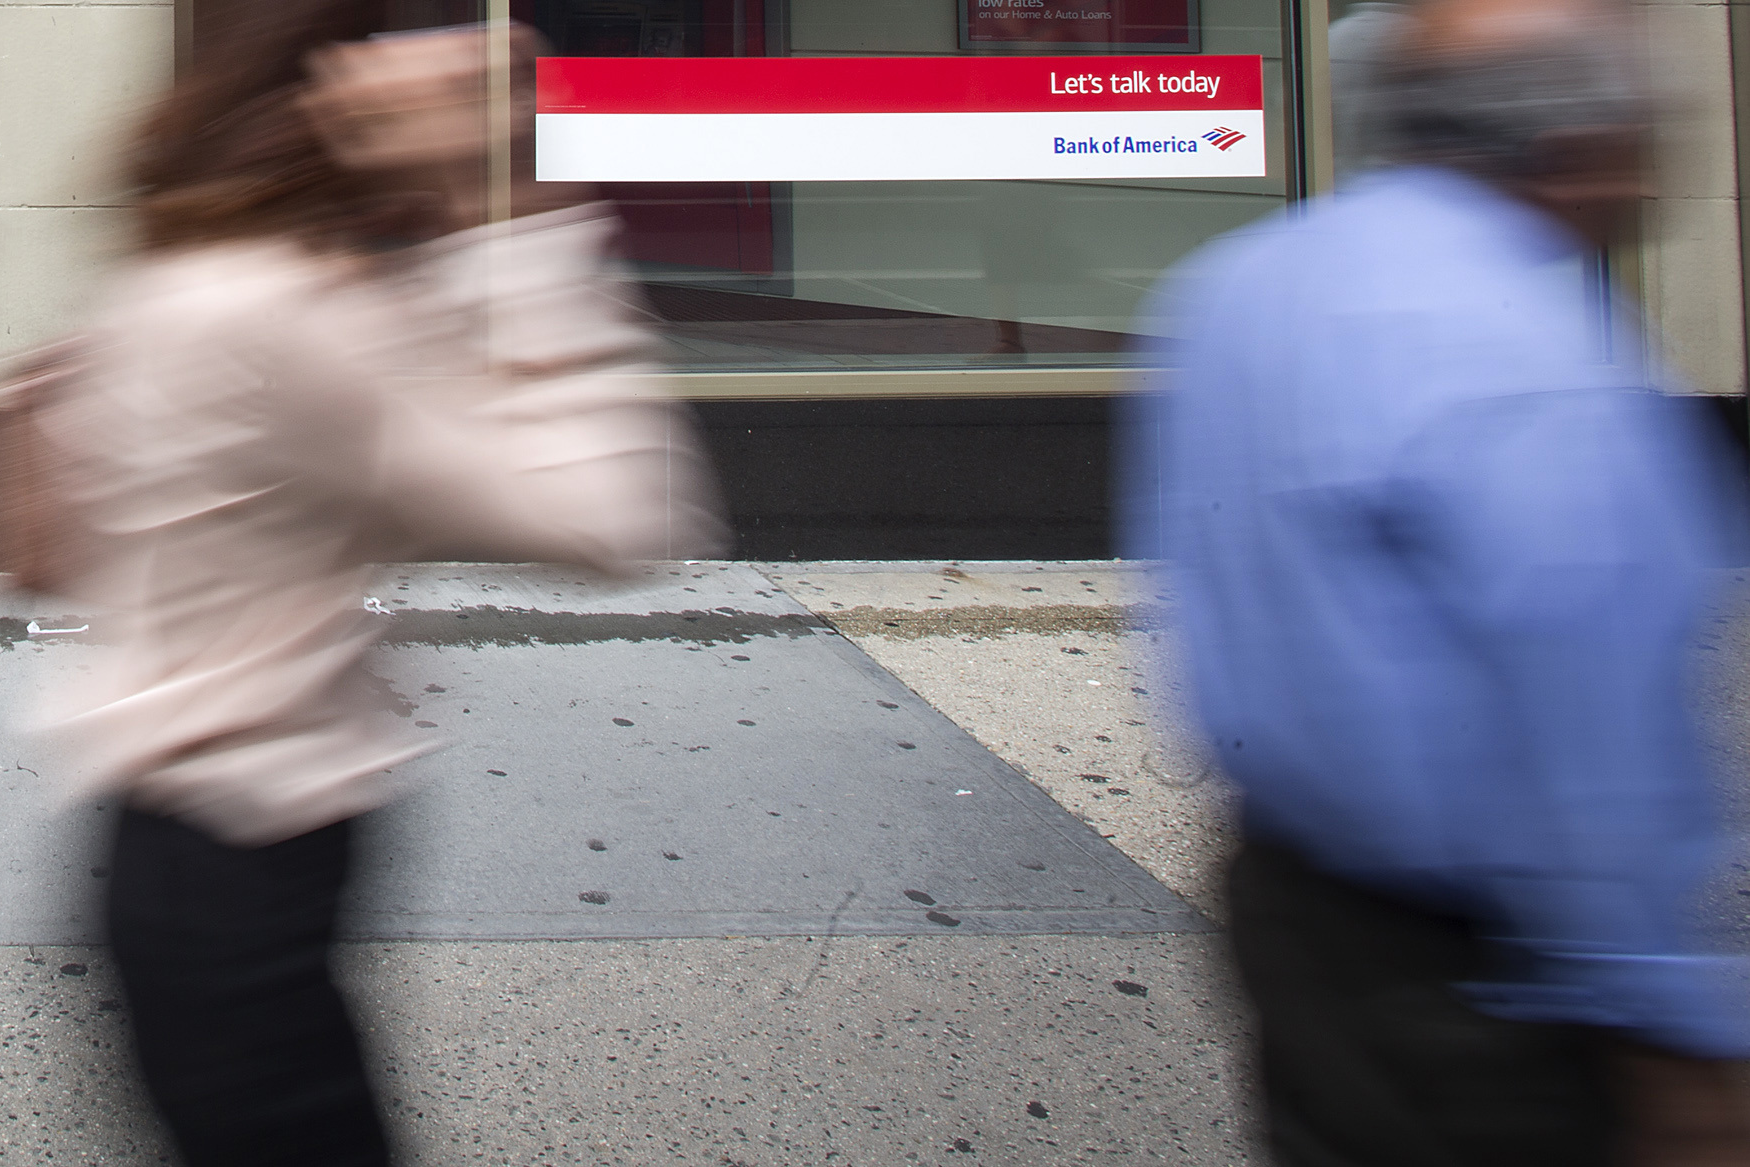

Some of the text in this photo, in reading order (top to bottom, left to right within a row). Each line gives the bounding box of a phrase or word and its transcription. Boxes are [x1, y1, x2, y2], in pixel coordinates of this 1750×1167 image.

[979, 10, 1112, 20] on our Home & Auto Loans
[1051, 70, 1220, 99] Let's talk today
[1053, 135, 1198, 154] Bank of America
